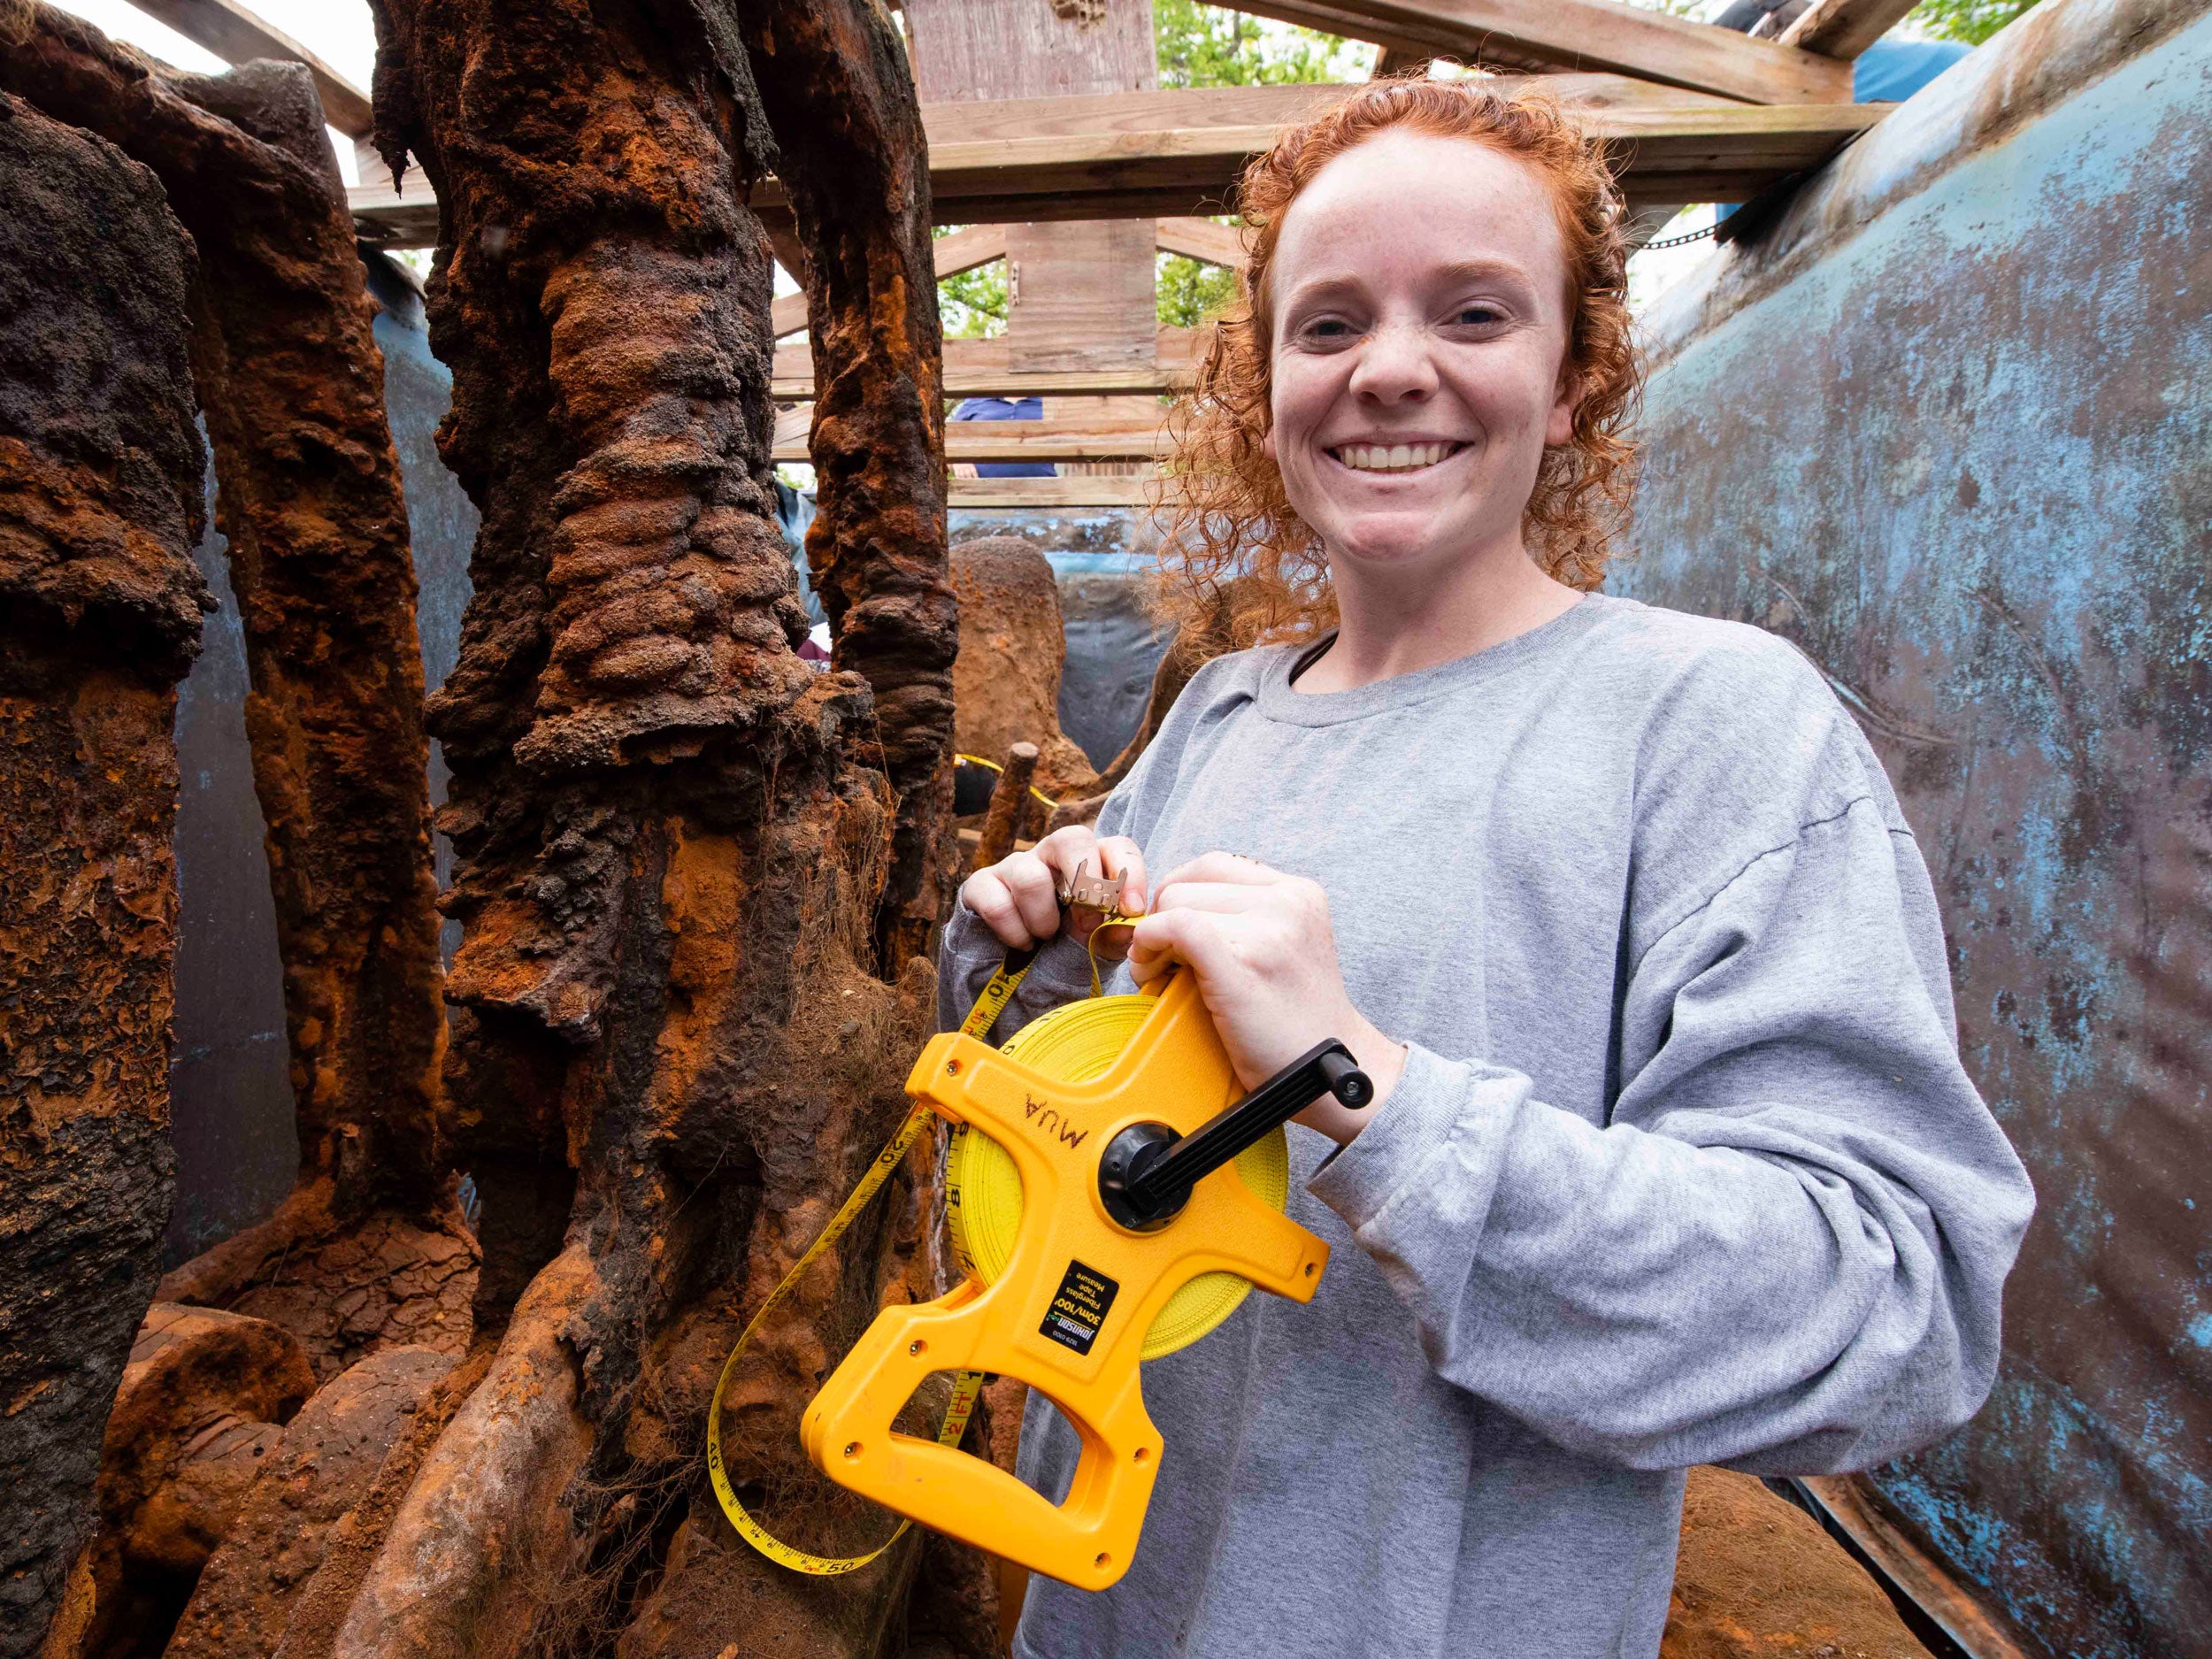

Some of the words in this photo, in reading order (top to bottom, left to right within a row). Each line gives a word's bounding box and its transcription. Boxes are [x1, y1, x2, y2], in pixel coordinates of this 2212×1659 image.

[1025, 1094, 1088, 1148] MUA
[879, 1138, 904, 1164] 20
[950, 1188, 961, 1208] 8
[1076, 1272, 1105, 1292] Measure
[1079, 1283, 1096, 1298] Tape
[1065, 1286, 1102, 1310] Fiberglass
[1056, 1317, 1095, 1341] JOHNSON
[709, 1442, 718, 1470] 40
[826, 1562, 856, 1573] 50
